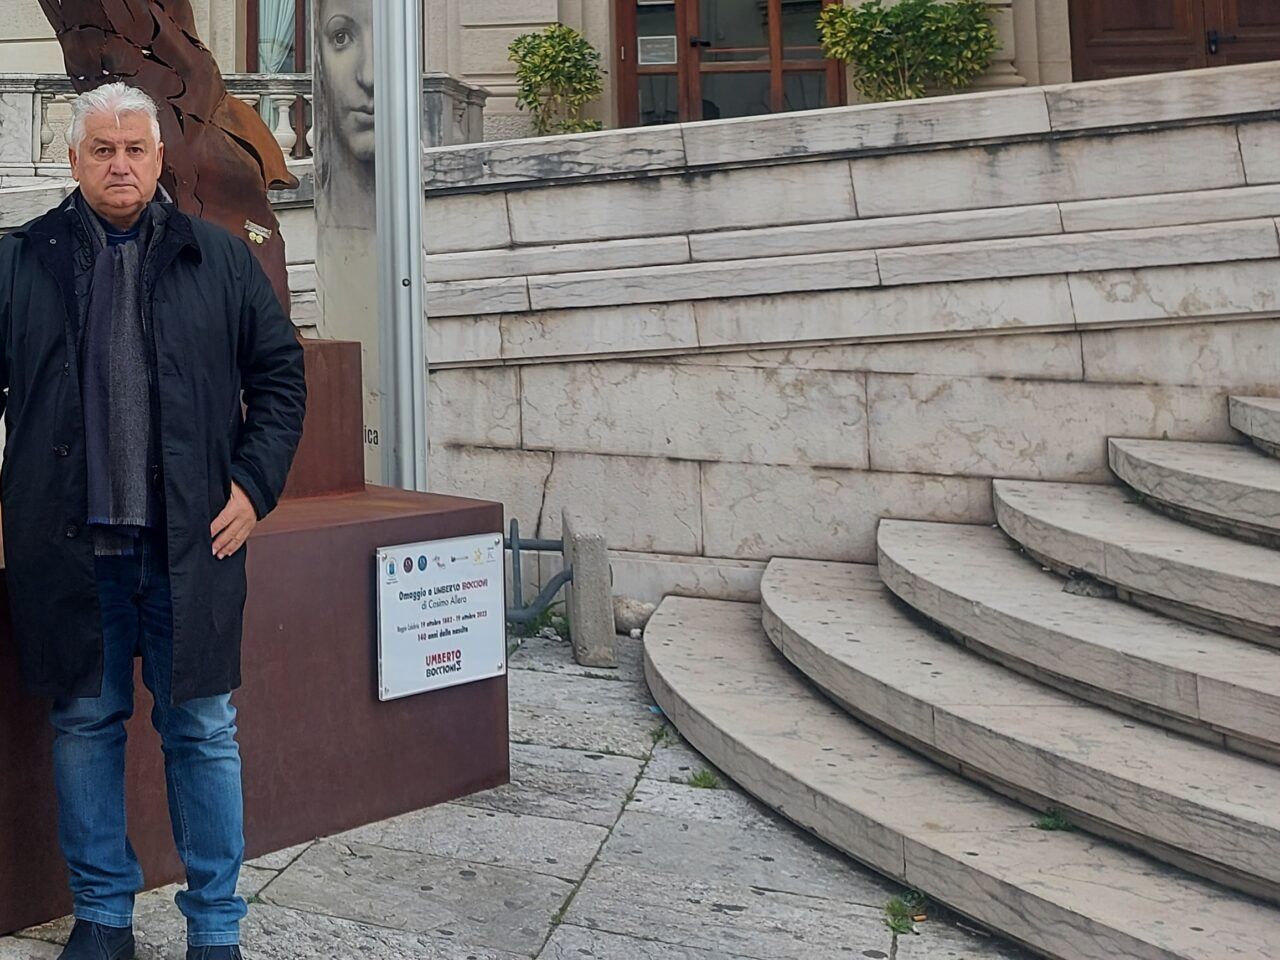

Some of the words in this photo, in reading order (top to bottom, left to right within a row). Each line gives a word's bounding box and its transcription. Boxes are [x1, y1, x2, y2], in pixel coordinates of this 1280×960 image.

[399, 587, 426, 601] Omaggio
[421, 600, 427, 610] di
[428, 598, 449, 609] Cosimo
[425, 649, 462, 667] UMBERTO
